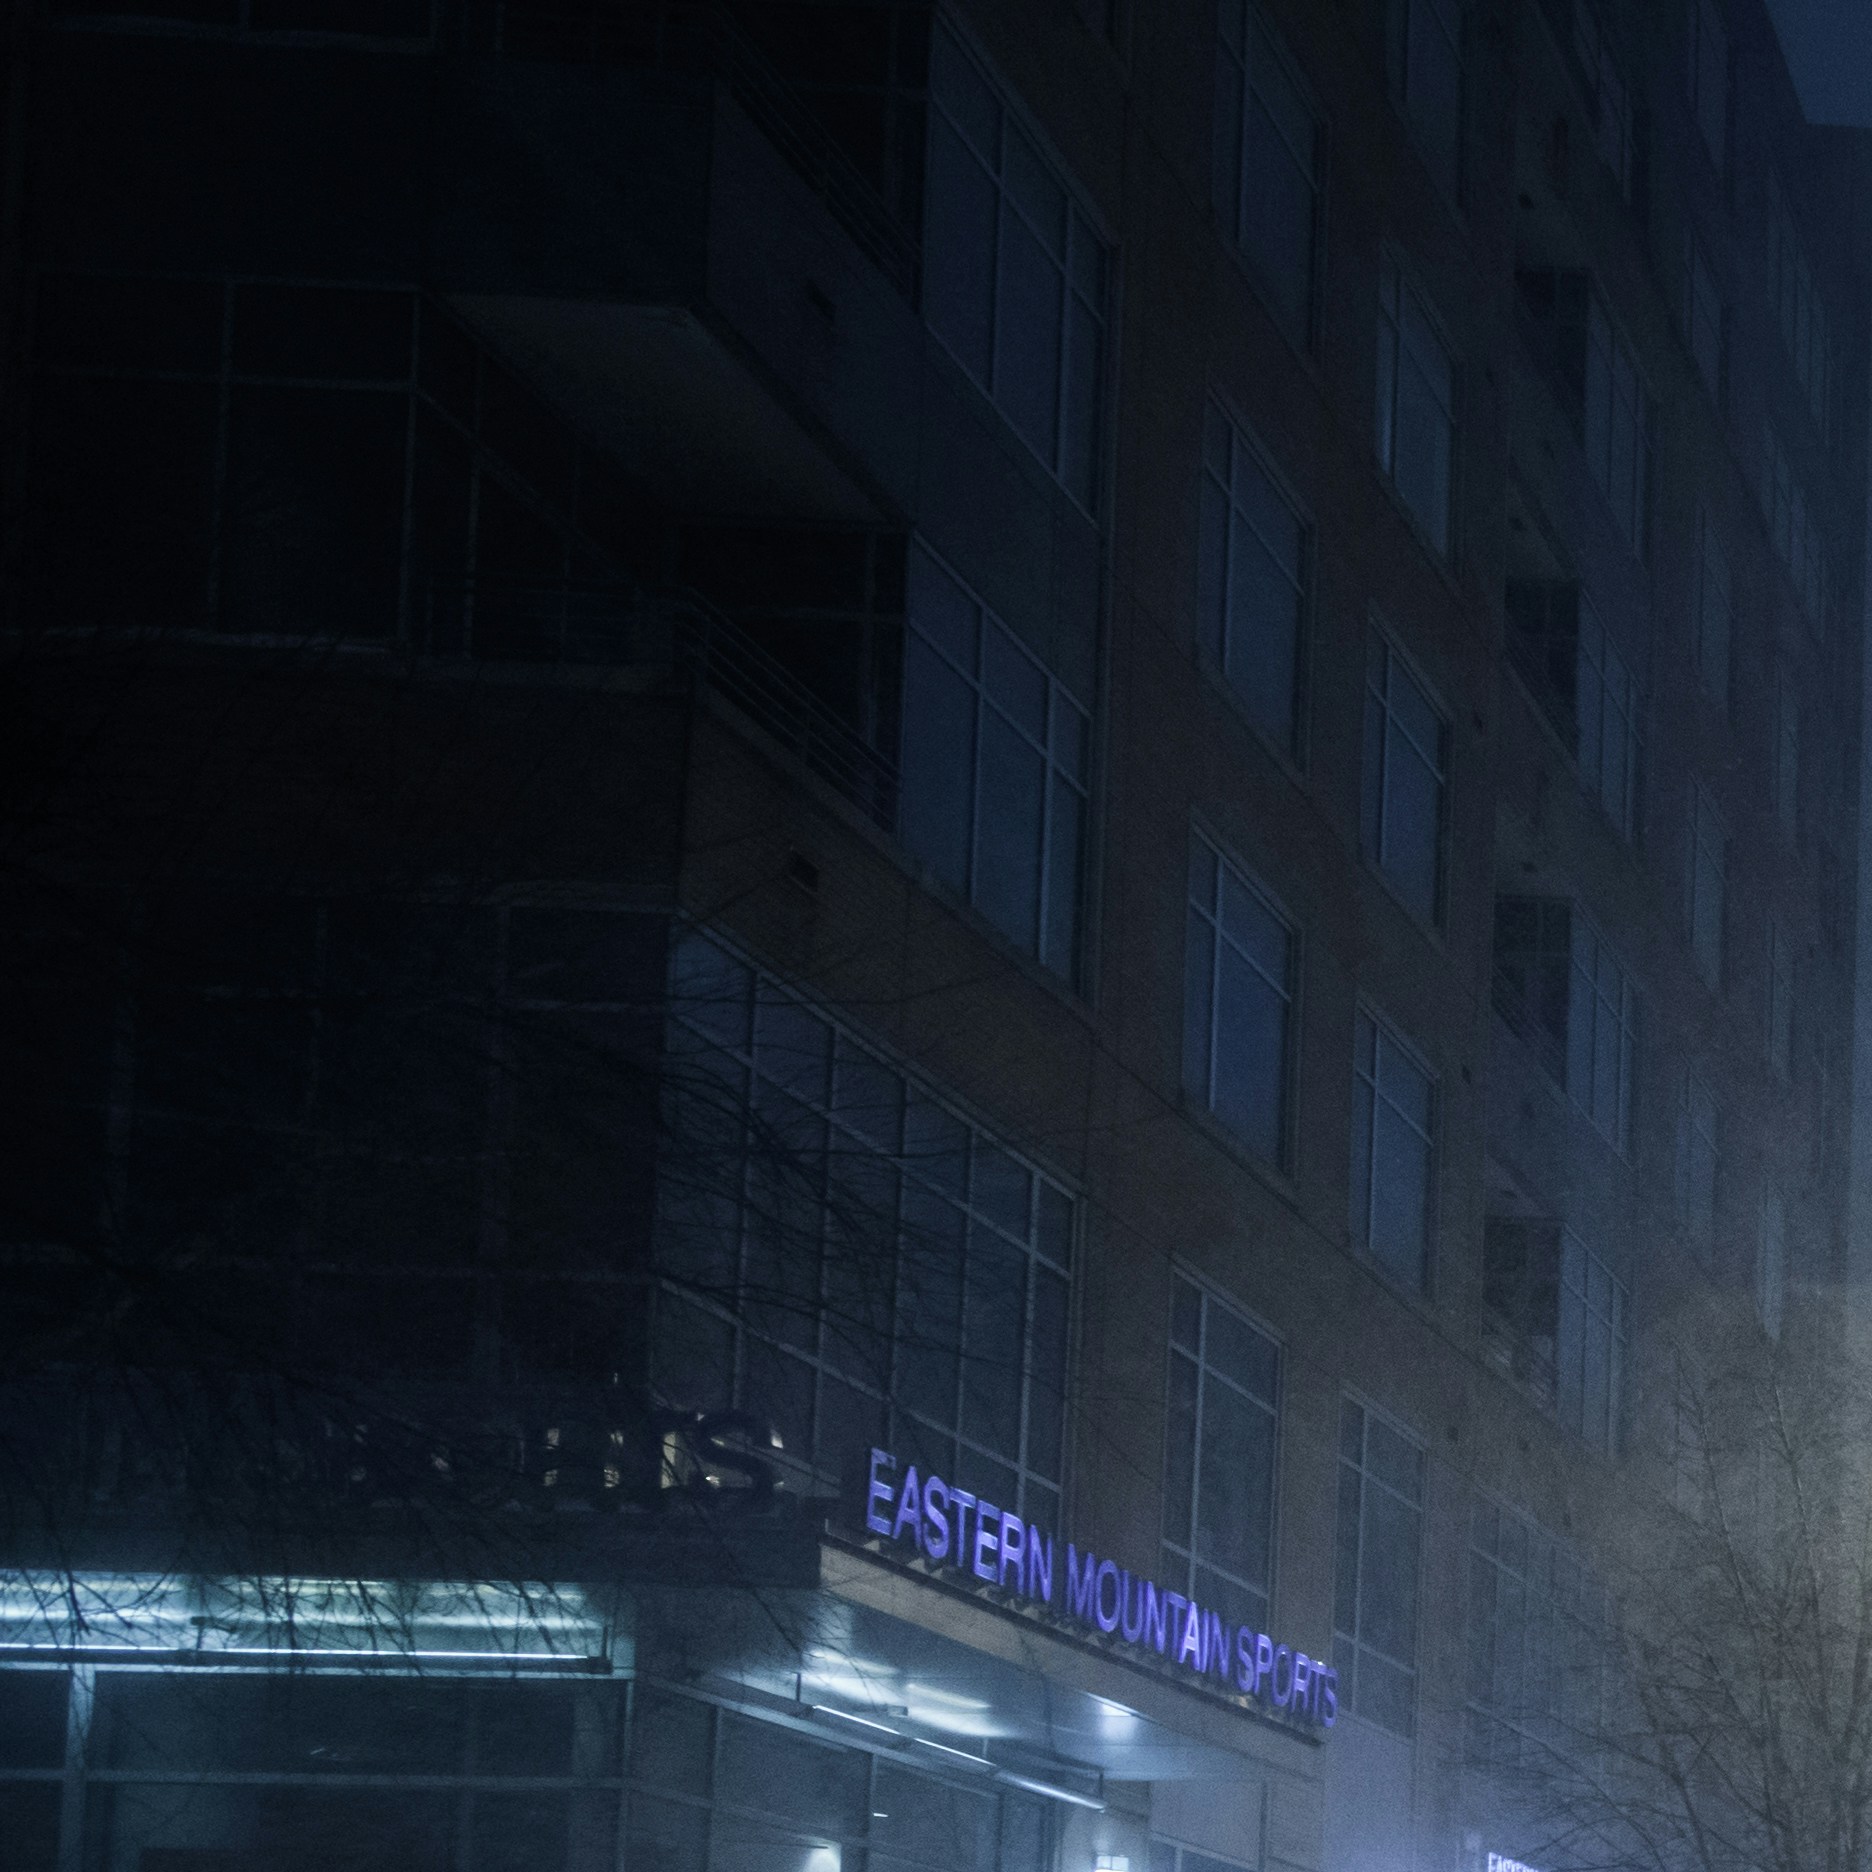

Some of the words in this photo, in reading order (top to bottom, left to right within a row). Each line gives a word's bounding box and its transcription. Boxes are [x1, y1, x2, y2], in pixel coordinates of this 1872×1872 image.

[866, 1446, 1053, 1602] EASTERN
[1065, 1543, 1231, 1681] MOUNTAIN
[1236, 1624, 1339, 1728] SPORTS
